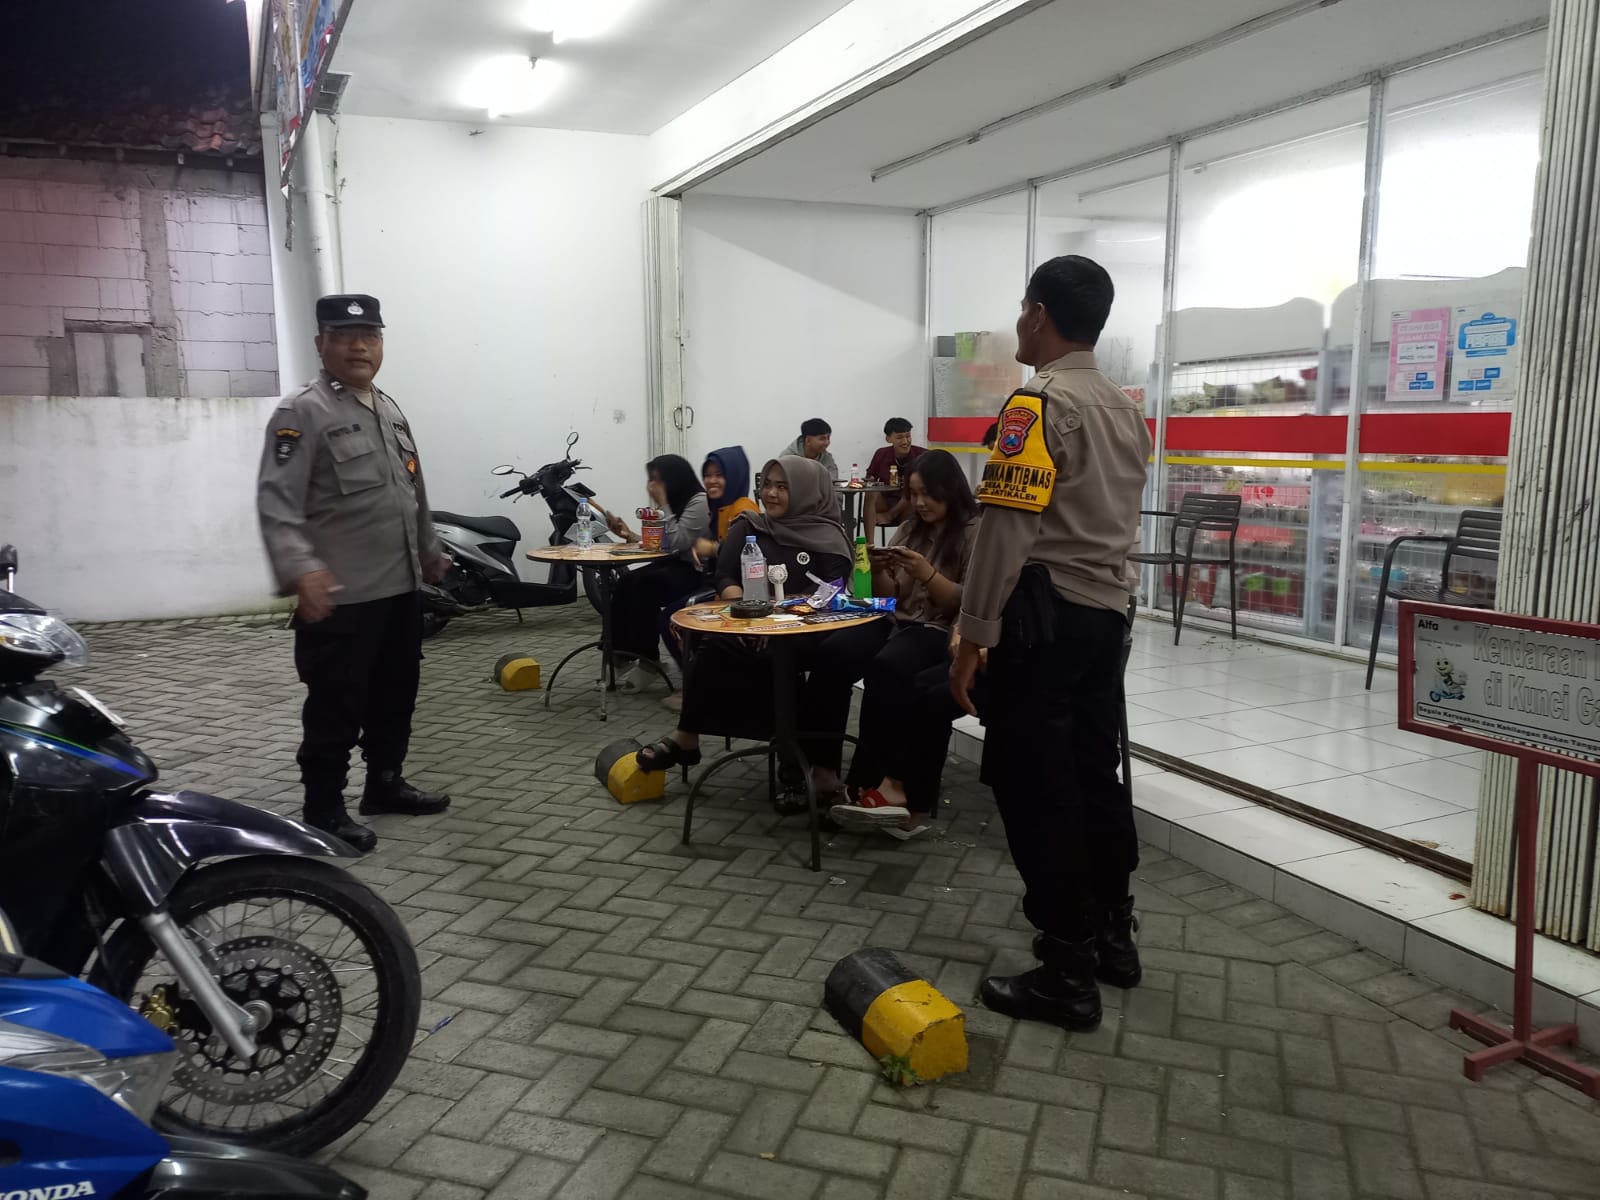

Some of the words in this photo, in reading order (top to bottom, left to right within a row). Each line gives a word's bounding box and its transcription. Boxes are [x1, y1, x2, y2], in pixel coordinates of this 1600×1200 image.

[1004, 483, 1027, 493] PULE
[1417, 618, 1439, 631] Alfa
[1473, 625, 1588, 680] Kendaraan
[1483, 670, 1503, 708] di
[1508, 673, 1571, 722] Kunci
